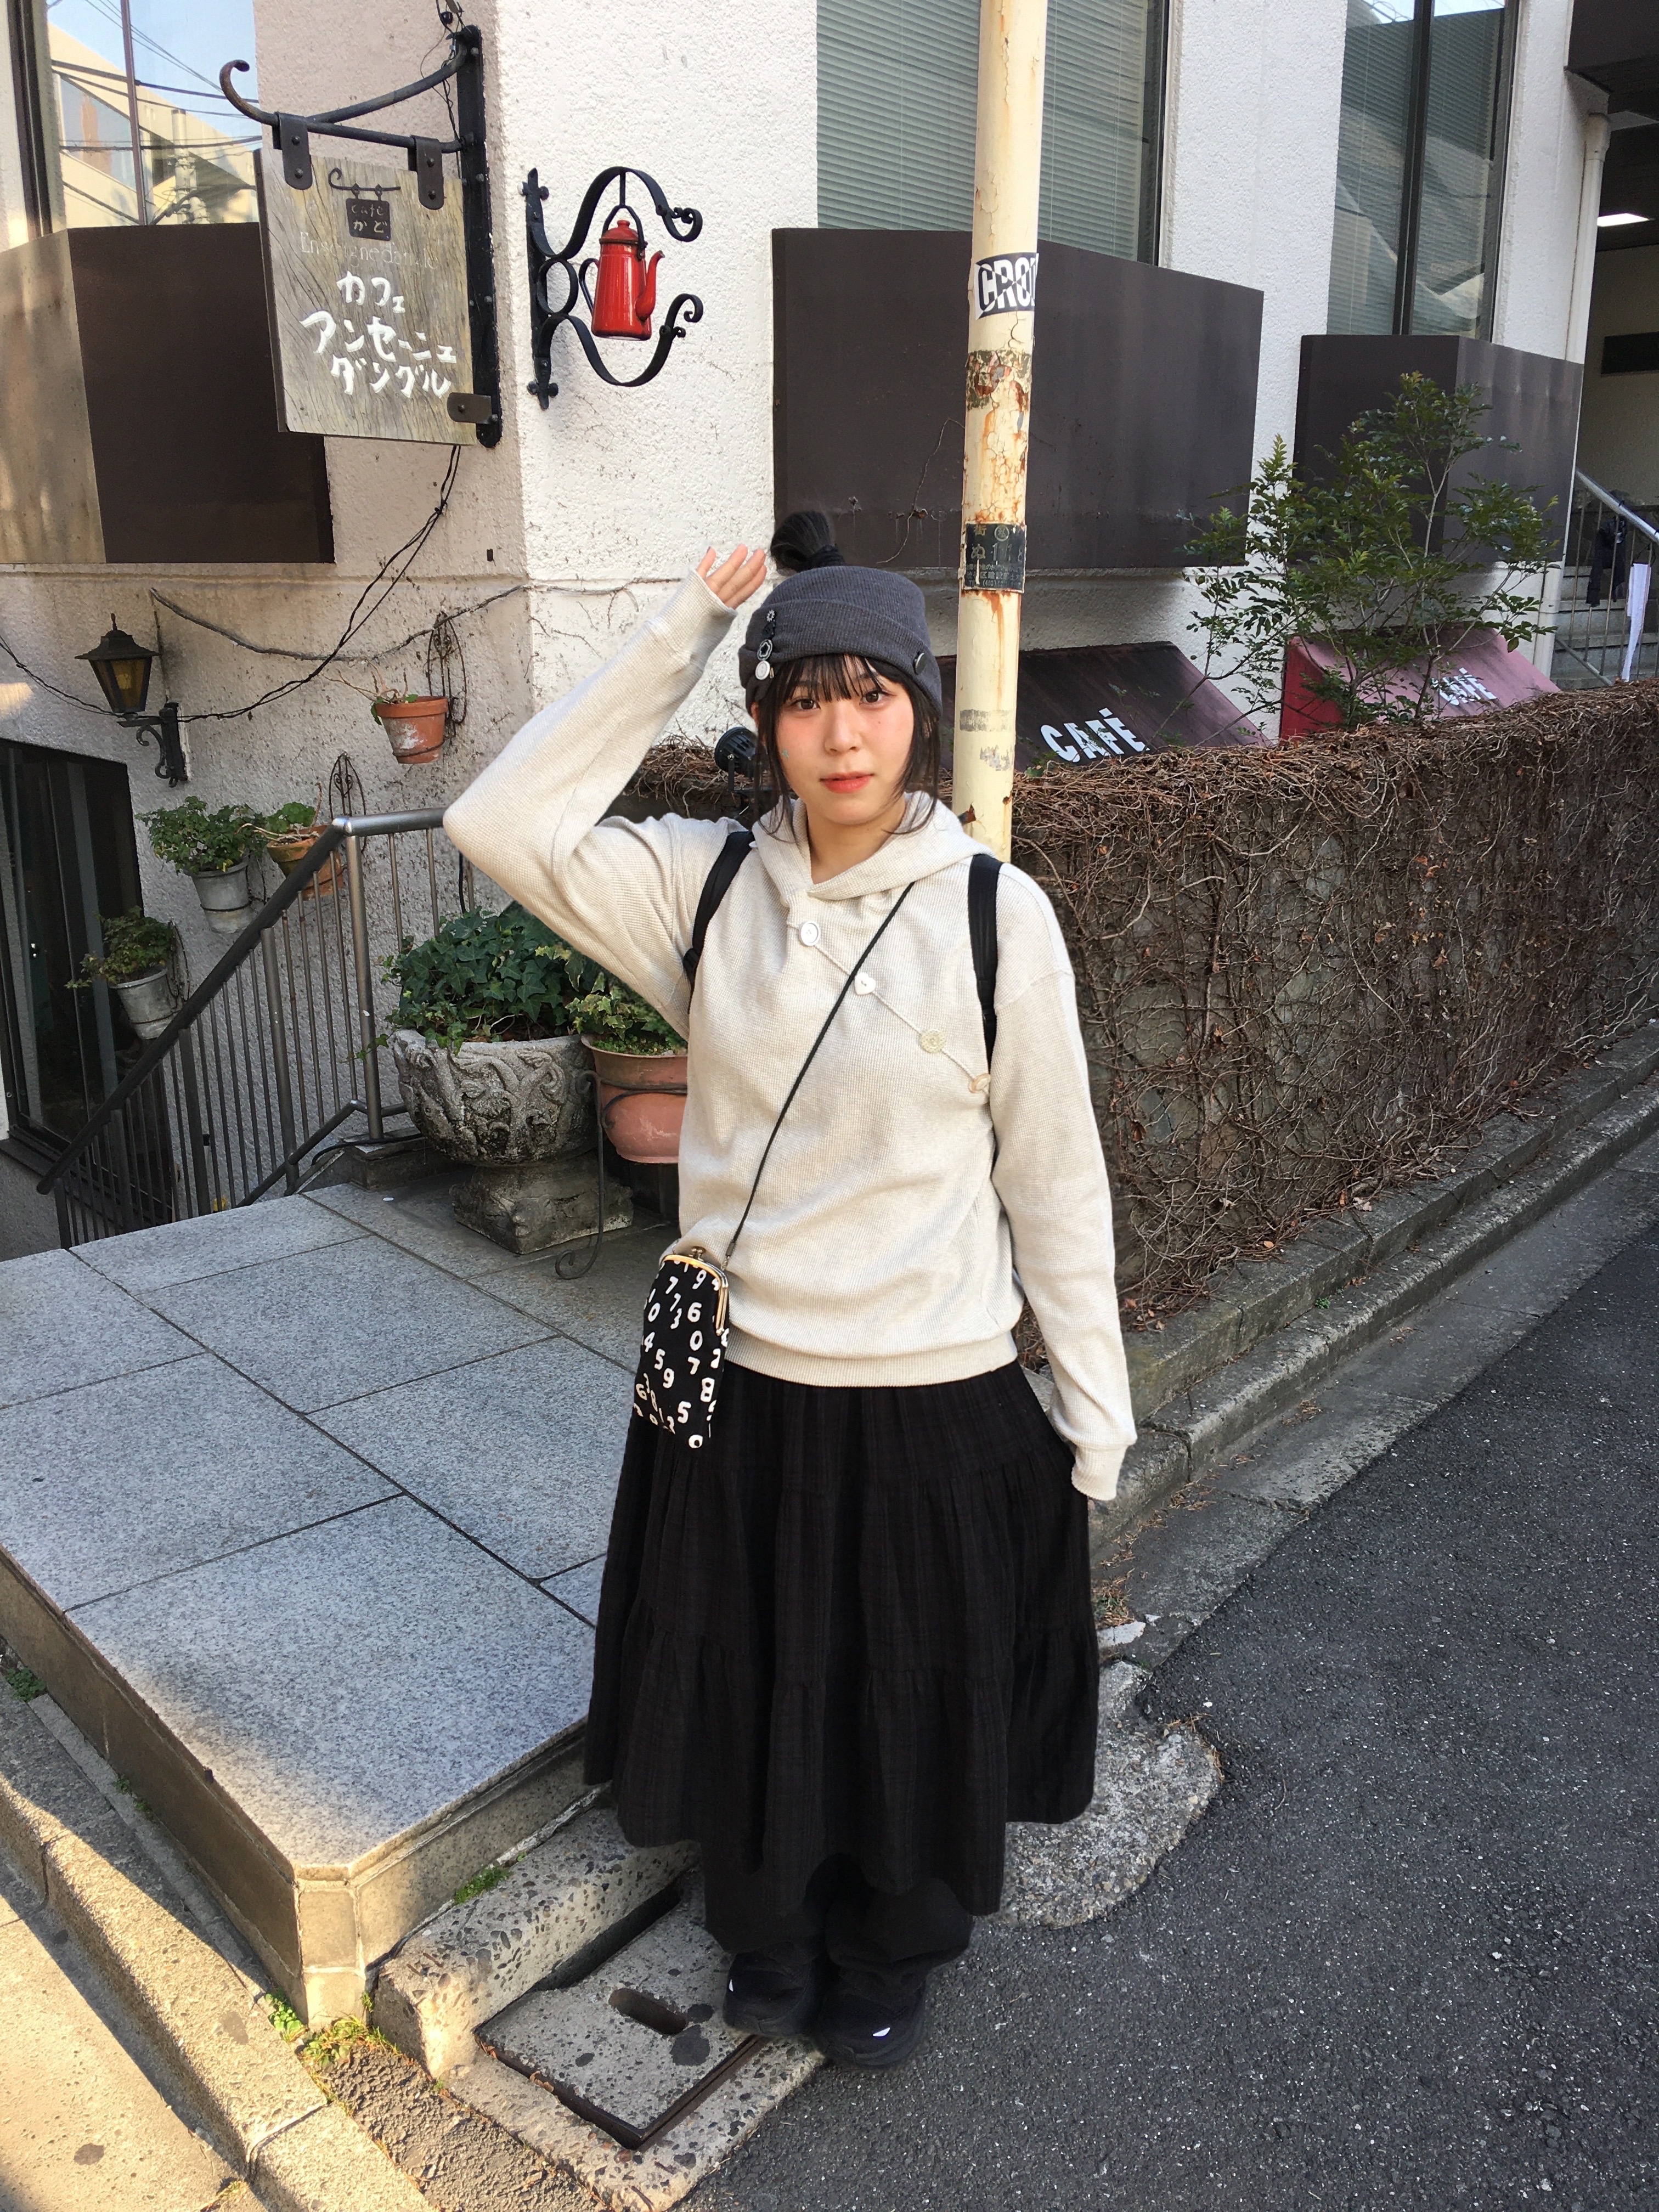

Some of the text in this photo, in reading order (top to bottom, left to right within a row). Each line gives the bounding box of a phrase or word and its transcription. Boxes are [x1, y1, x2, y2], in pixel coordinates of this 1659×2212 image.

[353, 220, 387, 233] かど
[336, 270, 405, 313] カフェ
[299, 309, 456, 364] アンセーニュ
[330, 355, 452, 399] ダングル
[1041, 707, 1150, 763] CAFÉ
[692, 1269, 707, 1290] 9
[648, 1302, 661, 1322] 0
[670, 1308, 682, 1329] 3
[687, 1302, 702, 1322] 6
[644, 1331, 656, 1352] 4
[690, 1330, 703, 1351] 0
[654, 1348, 666, 1370] 5
[687, 1356, 701, 1375] 7
[663, 1368, 675, 1389] 9
[636, 1383, 647, 1401] 6
[700, 1377, 715, 1402] 8
[678, 1401, 692, 1424] 5
